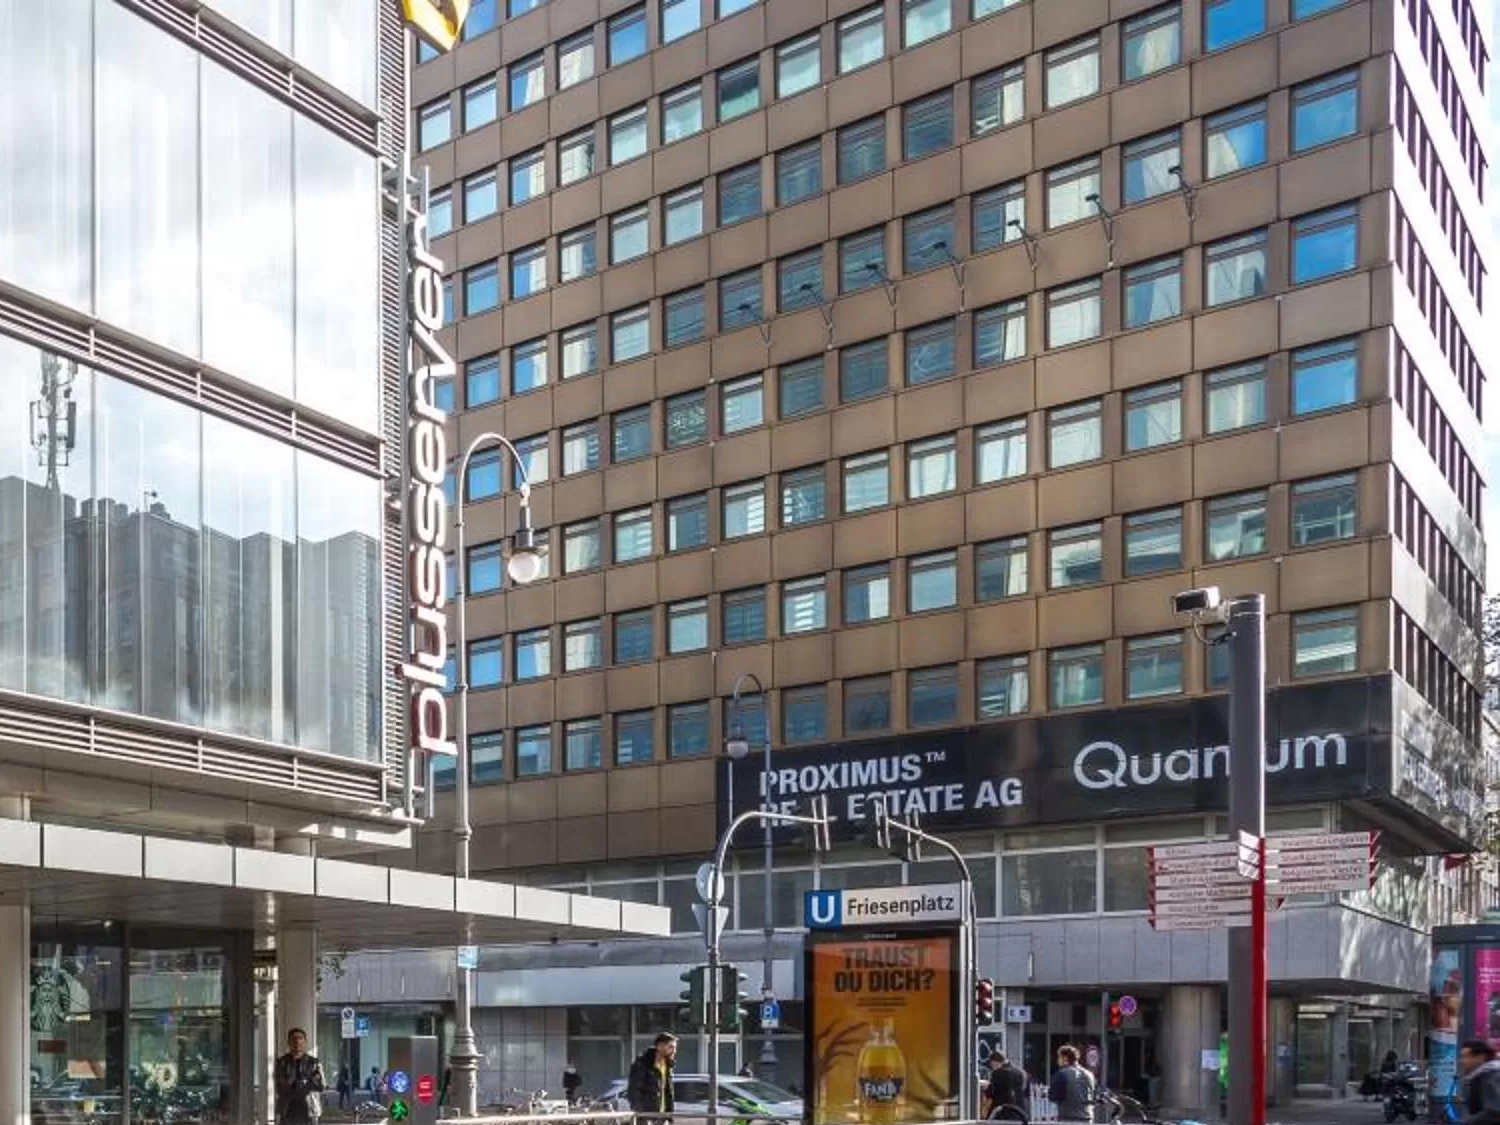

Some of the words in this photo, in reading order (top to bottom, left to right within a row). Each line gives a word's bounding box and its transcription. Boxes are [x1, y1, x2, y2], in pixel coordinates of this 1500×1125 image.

[401, 212, 458, 755] plusserver
[1073, 733, 1348, 789] Quanum
[974, 777, 1023, 809] AG
[811, 896, 835, 923] U
[847, 894, 955, 918] Friesenplatz
[835, 971, 862, 993] DU
[868, 967, 935, 993] DICH?
